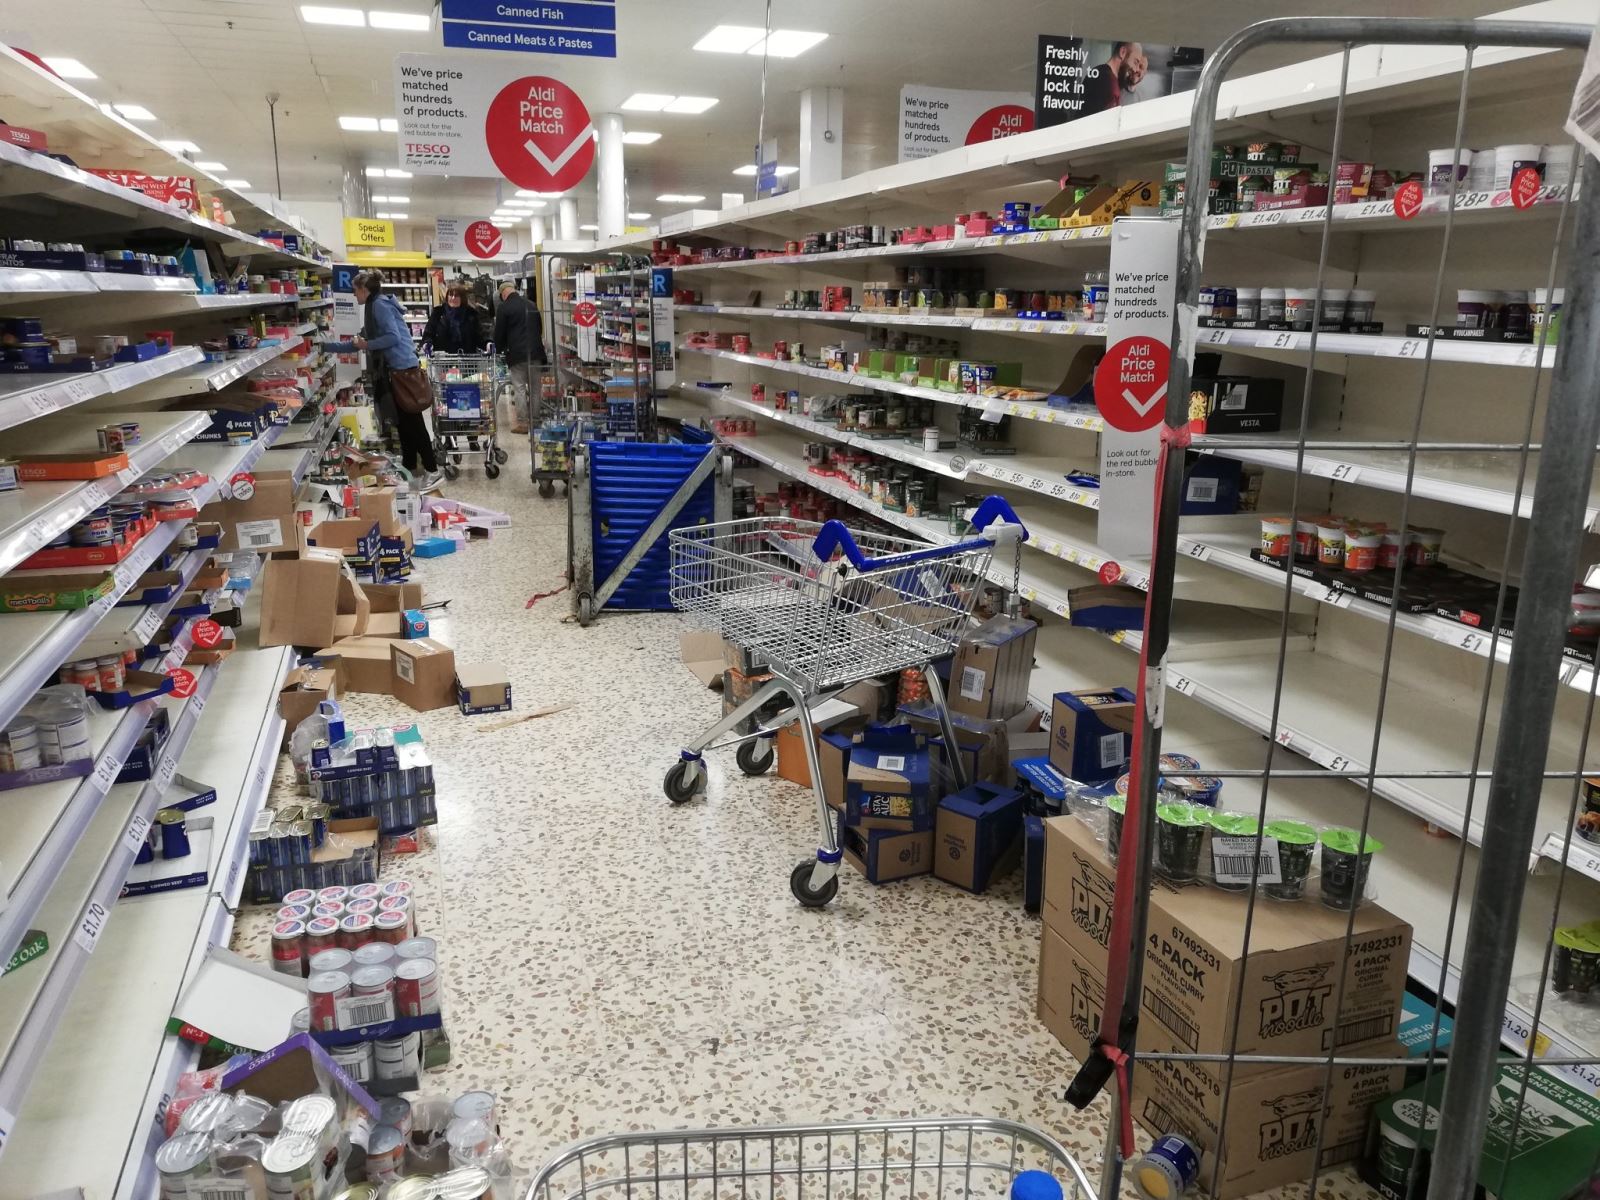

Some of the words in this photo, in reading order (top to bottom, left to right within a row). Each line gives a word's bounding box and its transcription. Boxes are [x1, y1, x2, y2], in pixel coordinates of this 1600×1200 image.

[496, 5, 540, 18] Canned
[542, 8, 564, 20] Fish
[468, 30, 511, 44] Canned
[514, 33, 546, 46] Meats
[548, 36, 556, 47] &
[558, 37, 593, 50] Pastes
[1045, 45, 1089, 64] Freshly
[401, 67, 433, 78] We've
[436, 69, 463, 81] price
[1044, 62, 1083, 78] frozen
[1086, 65, 1100, 78] to
[402, 80, 449, 92] matched
[1044, 78, 1070, 93] lock
[1073, 80, 1085, 94] in
[403, 93, 453, 105] hundreds
[528, 87, 555, 102] Aldi
[905, 96, 927, 107] We've
[928, 99, 950, 111] price
[1042, 94, 1085, 111] flavour
[403, 106, 415, 117] of
[417, 107, 468, 120] products.
[520, 101, 564, 119] Price
[905, 109, 938, 121] matched
[404, 122, 418, 130] Look
[441, 123, 452, 131] the
[520, 119, 564, 135] Match
[904, 120, 940, 132] hundreds
[999, 114, 1022, 127] Aldi
[904, 132, 913, 141] of
[914, 133, 951, 144] products.
[405, 143, 450, 154] TESCO
[1247, 152, 1265, 161] POT
[1221, 161, 1246, 176] POT
[1274, 180, 1291, 190] POT
[1520, 178, 1535, 189] Price
[1403, 191, 1418, 200] Price
[1252, 213, 1280, 224] £1.40
[358, 222, 385, 235] Special
[1062, 230, 1073, 239] £1
[1092, 226, 1104, 236] £1
[360, 233, 385, 243] Offers
[654, 275, 666, 292] R
[1115, 272, 1143, 282] We've
[1145, 273, 1169, 285] price
[1115, 285, 1155, 294] matched
[1114, 297, 1157, 307] hundreds
[1113, 309, 1123, 319] of
[1125, 309, 1169, 321] products.
[1210, 331, 1224, 343] £1
[1274, 333, 1291, 347] £1
[1128, 345, 1150, 357] Aldi
[1398, 341, 1420, 356] £1
[1121, 357, 1155, 371] Price
[1120, 372, 1155, 383] Match
[1240, 419, 1260, 427] VESTA
[1106, 450, 1125, 458] Look
[1127, 450, 1139, 458] out
[1140, 448, 1151, 458] for
[1106, 459, 1118, 468] the
[1120, 459, 1132, 468] red
[1106, 468, 1136, 478] in-store.
[1332, 465, 1351, 478] £1
[1190, 544, 1205, 557] £1
[1259, 555, 1270, 564] POT
[1332, 580, 1344, 589] POT
[1325, 589, 1344, 604] £1
[1437, 608, 1448, 616] POT
[1460, 634, 1483, 651] £1
[1563, 647, 1576, 655] POT
[1175, 677, 1191, 692] £1
[98, 755, 118, 782] £1.40
[160, 756, 175, 780] £1.05
[1331, 757, 1350, 771] £1
[128, 815, 147, 842] £1.70
[82, 903, 105, 939] £1.70
[20, 941, 45, 961] Oak
[1172, 926, 1221, 973] 67492331
[1149, 933, 1159, 949] 4
[1162, 940, 1207, 988] PACK
[1362, 953, 1392, 967] PACK
[1147, 949, 1179, 984] ORIGINAL
[1180, 977, 1205, 1003] CURRY
[1354, 965, 1390, 977] ORIGINAL
[1358, 973, 1384, 983] CURRY
[1160, 972, 1188, 997] FLAVOUR
[1260, 984, 1332, 1036] POT
[1259, 1010, 1325, 1040] noodle
[1164, 1060, 1206, 1108] PACK
[1361, 1075, 1390, 1088] PACK
[1528, 1071, 1575, 1097] FASTEST
[1528, 1078, 1566, 1100] SNACK
[1175, 1089, 1218, 1135] MUSHROOM
[1380, 1183, 1401, 1200] POT
